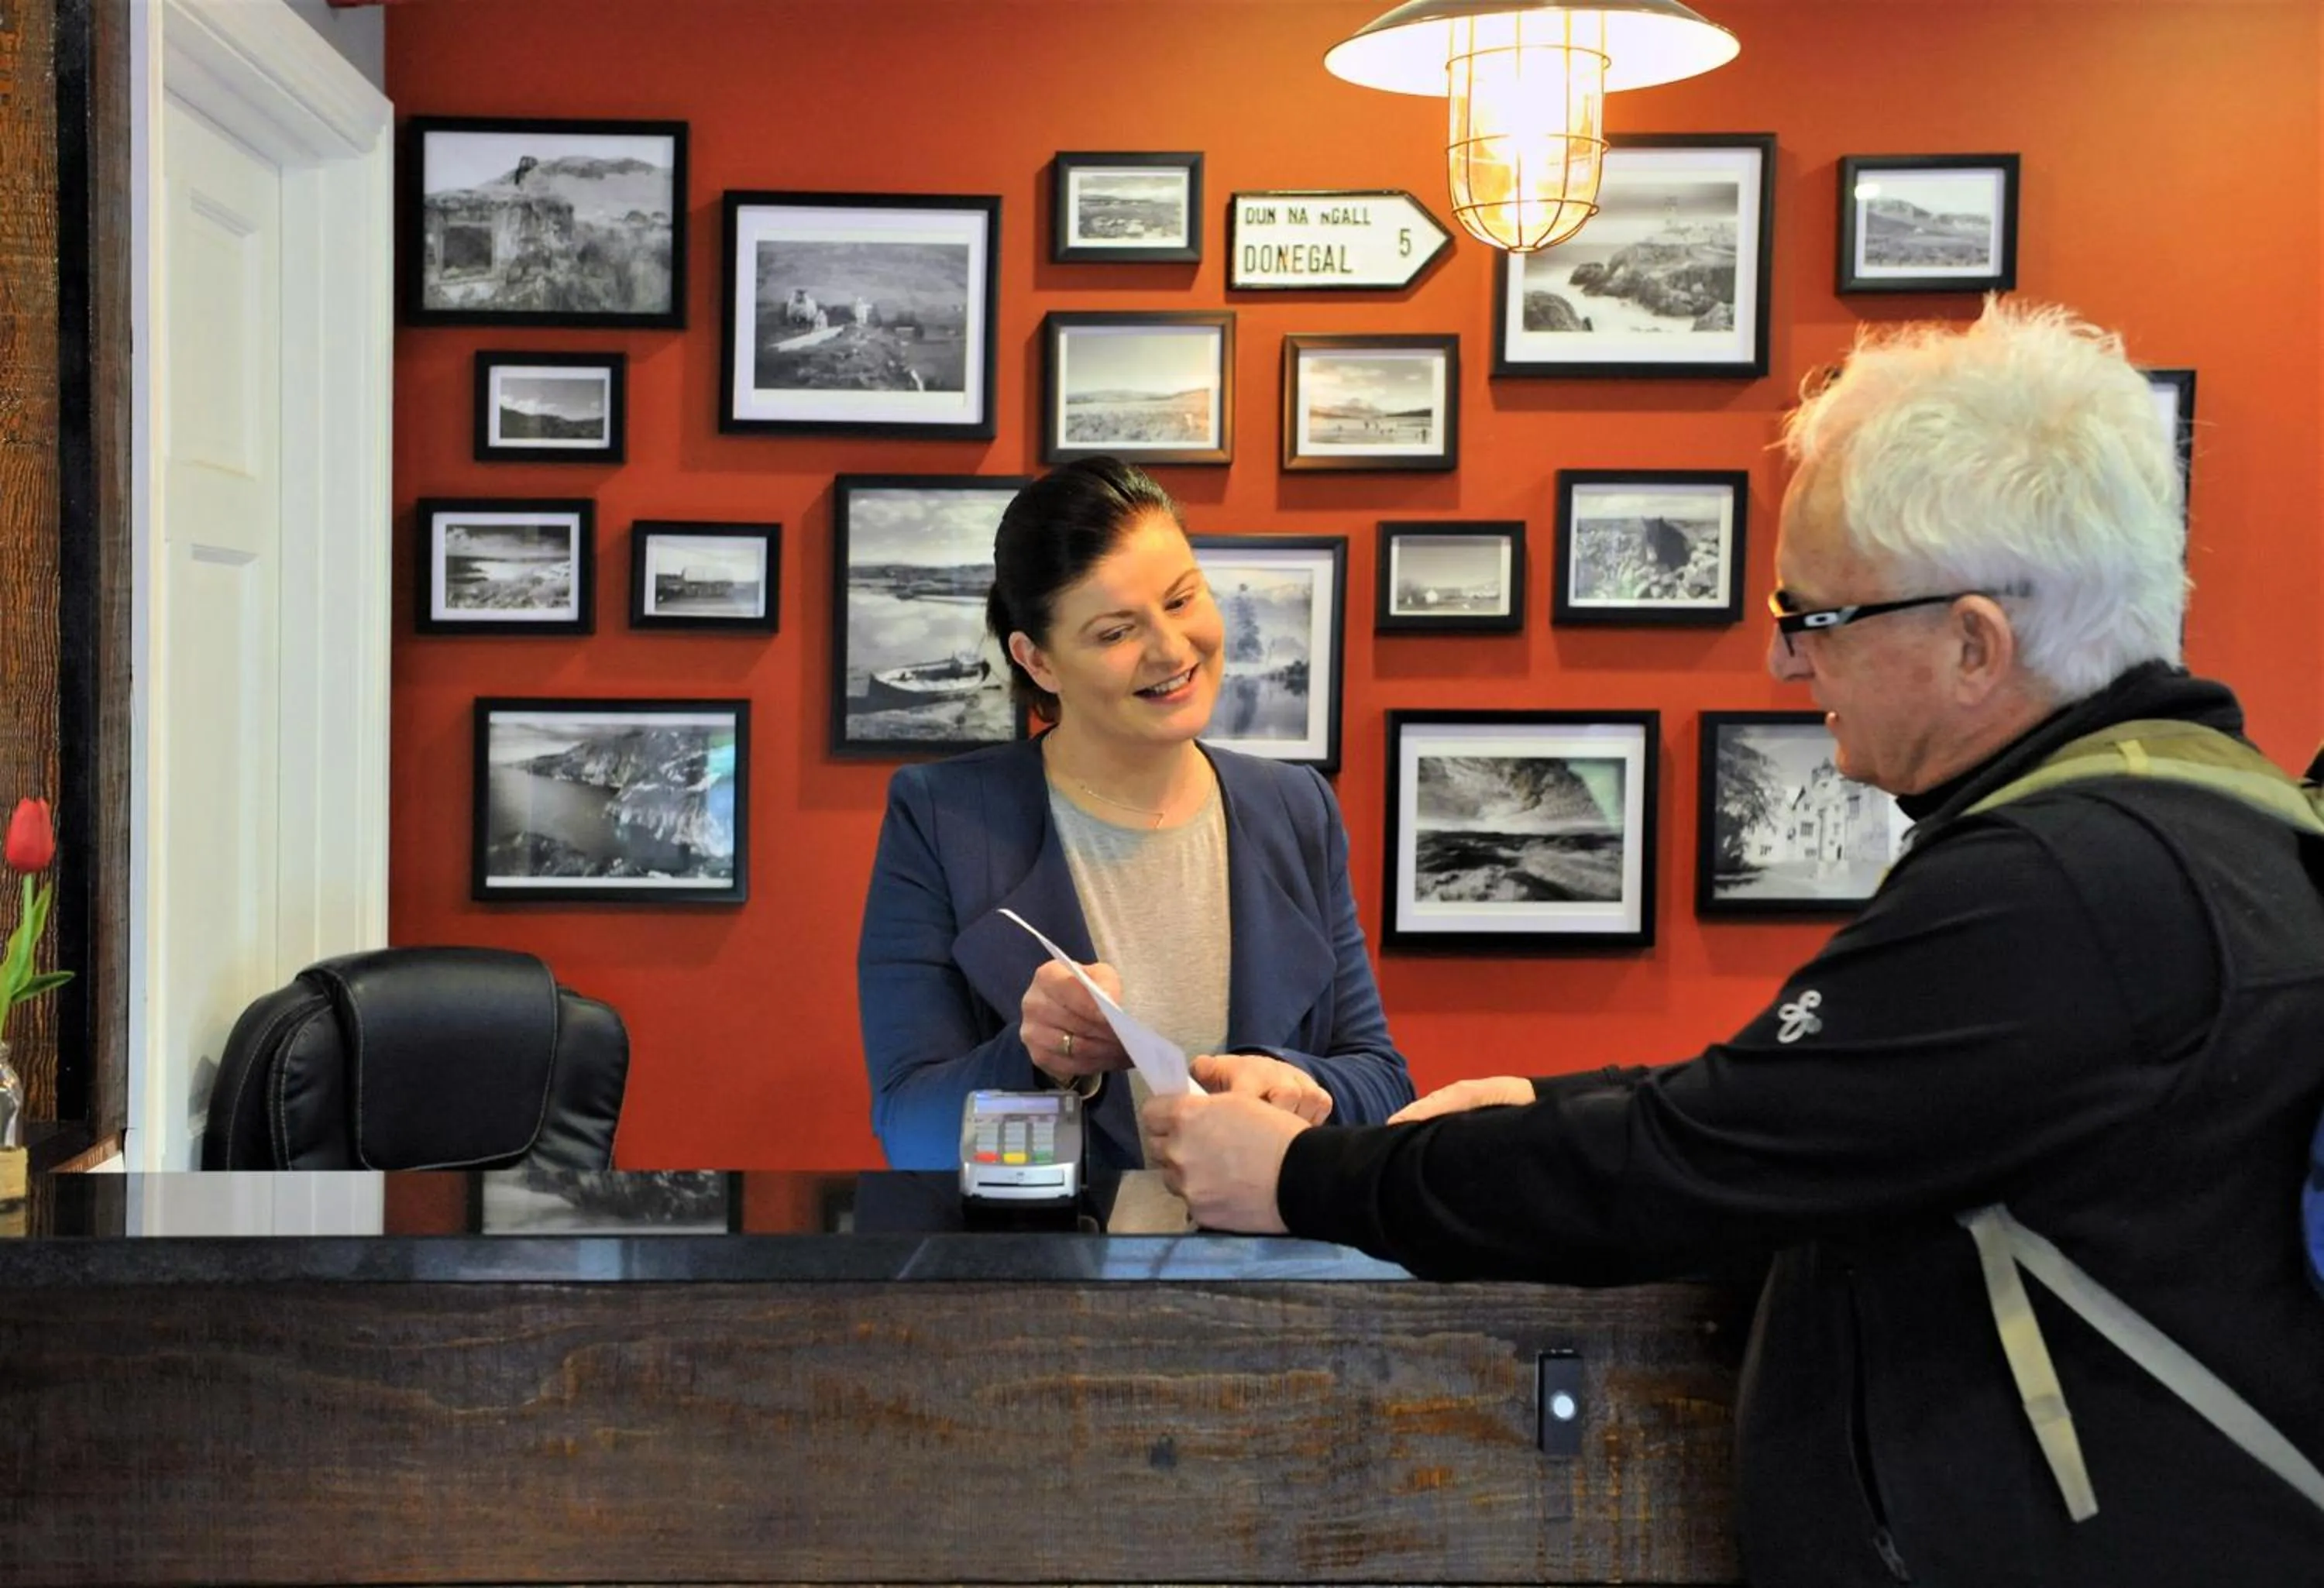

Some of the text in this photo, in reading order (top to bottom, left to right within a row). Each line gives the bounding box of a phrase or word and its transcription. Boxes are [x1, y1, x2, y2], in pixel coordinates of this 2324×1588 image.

[1288, 207, 1308, 224] NA
[1399, 229, 1411, 256] 5
[1244, 245, 1352, 273] DONEGAL
